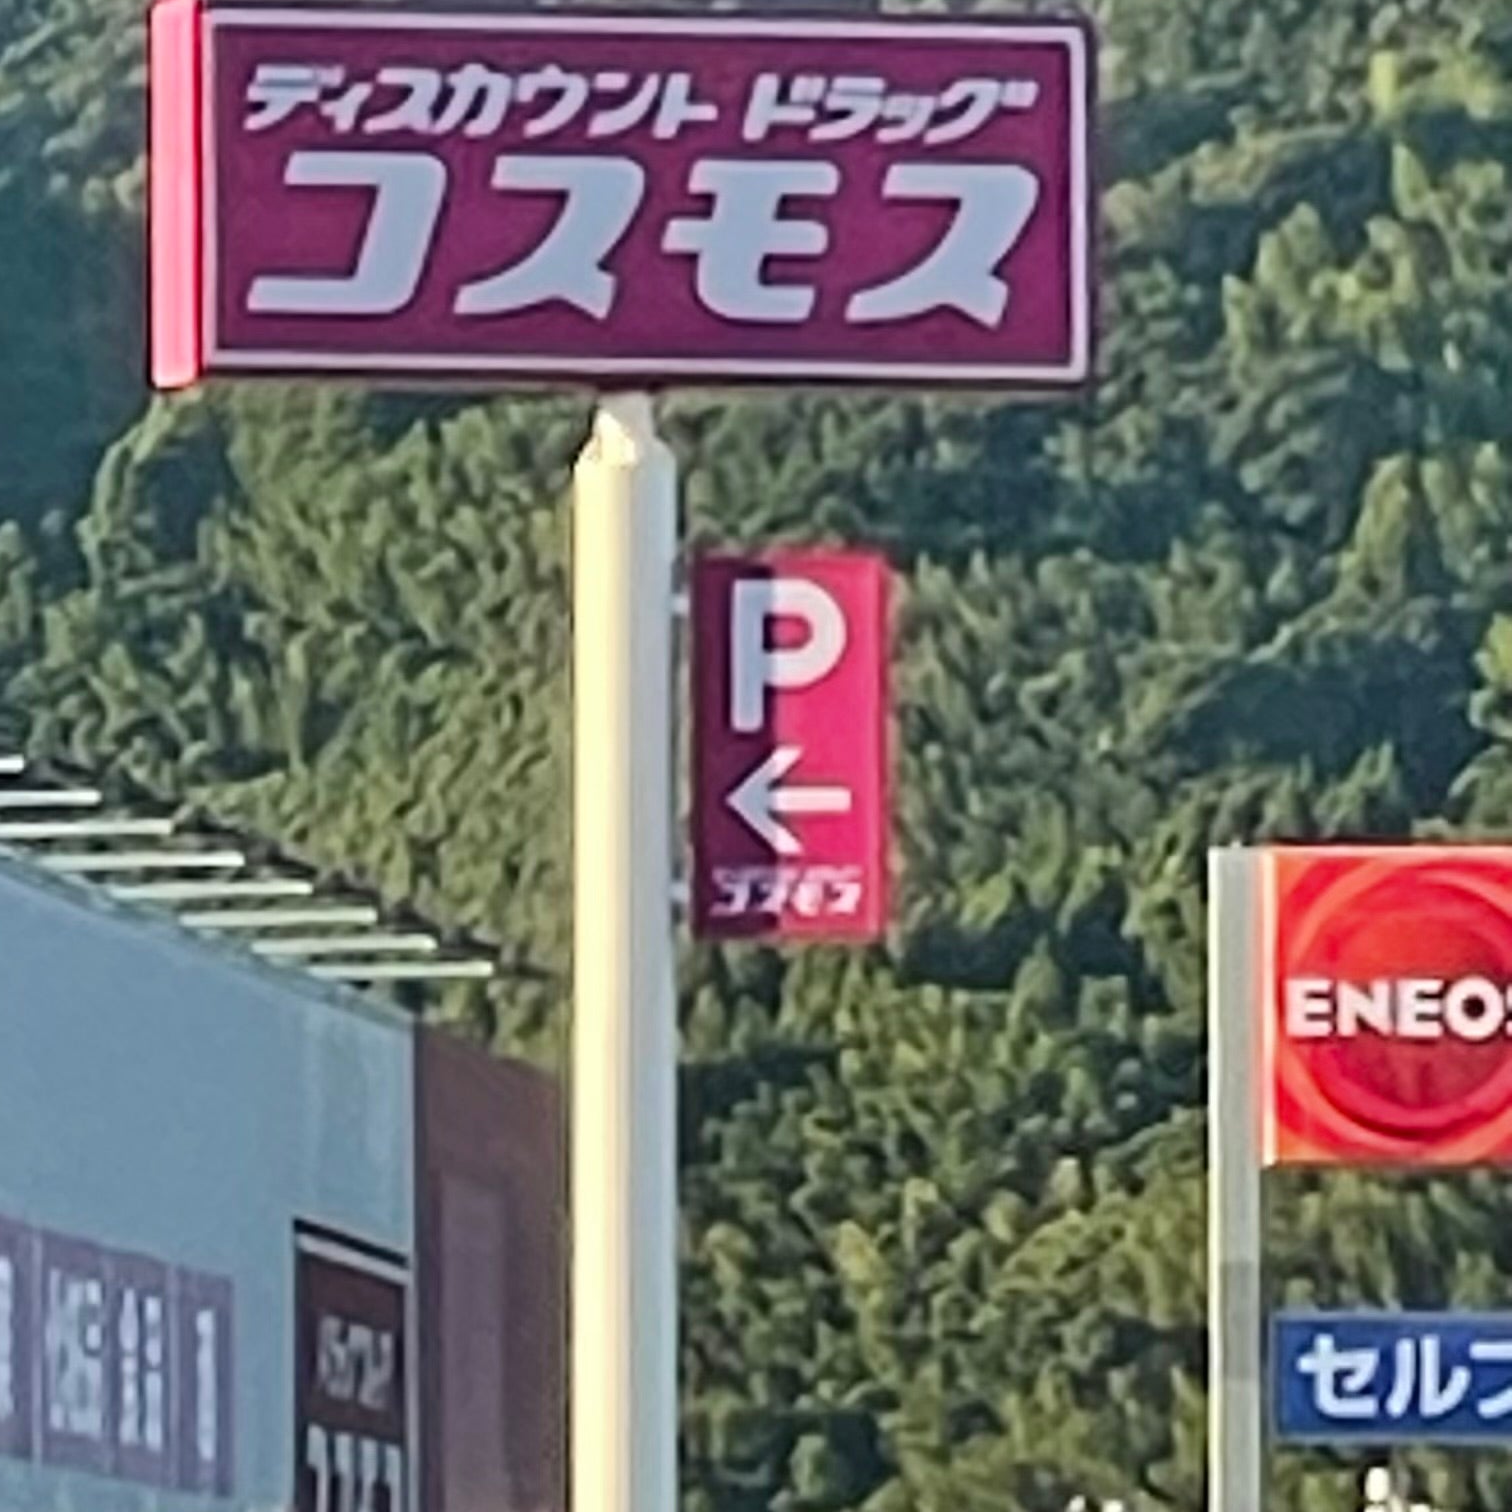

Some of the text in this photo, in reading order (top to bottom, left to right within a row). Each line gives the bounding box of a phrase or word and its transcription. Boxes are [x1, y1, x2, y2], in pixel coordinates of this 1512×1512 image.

[243, 62, 1039, 144] ディスカウント ドラッグ
[245, 150, 1041, 330] コスモス
[730, 577, 848, 734] P
[1285, 975, 1512, 1041] ENEO
